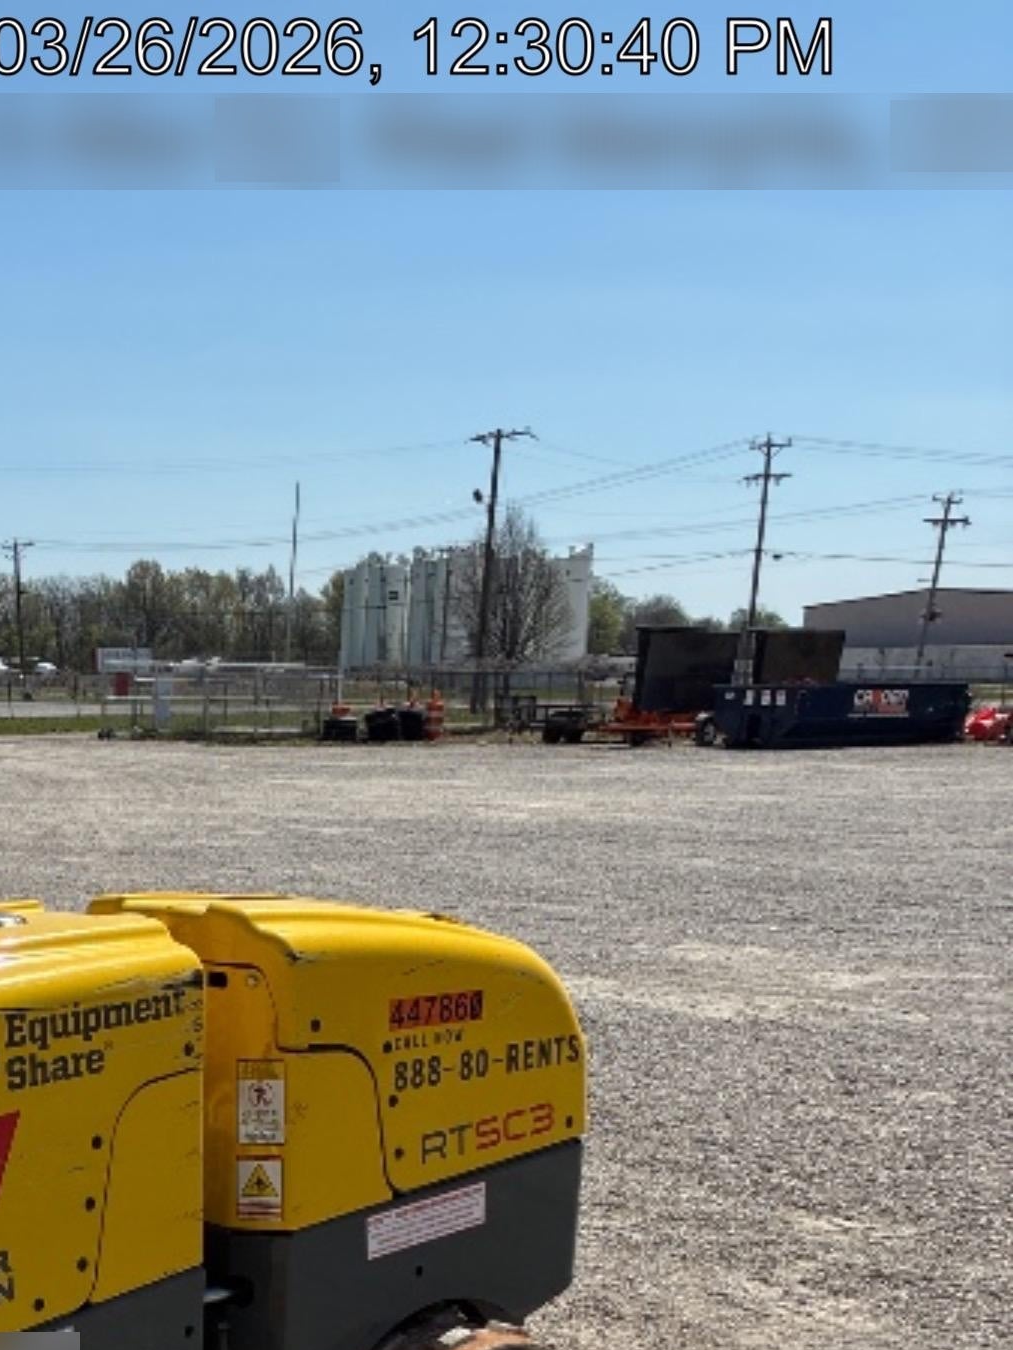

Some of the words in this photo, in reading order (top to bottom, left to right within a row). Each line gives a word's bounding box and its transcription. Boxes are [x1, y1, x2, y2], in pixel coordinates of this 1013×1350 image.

[4, 989, 187, 1050] Equipment
[390, 990, 483, 1029] 447860
[394, 1032, 428, 1051] CALL
[394, 1033, 581, 1092] 888-80-RENTS
[4, 1049, 105, 1092] Share
